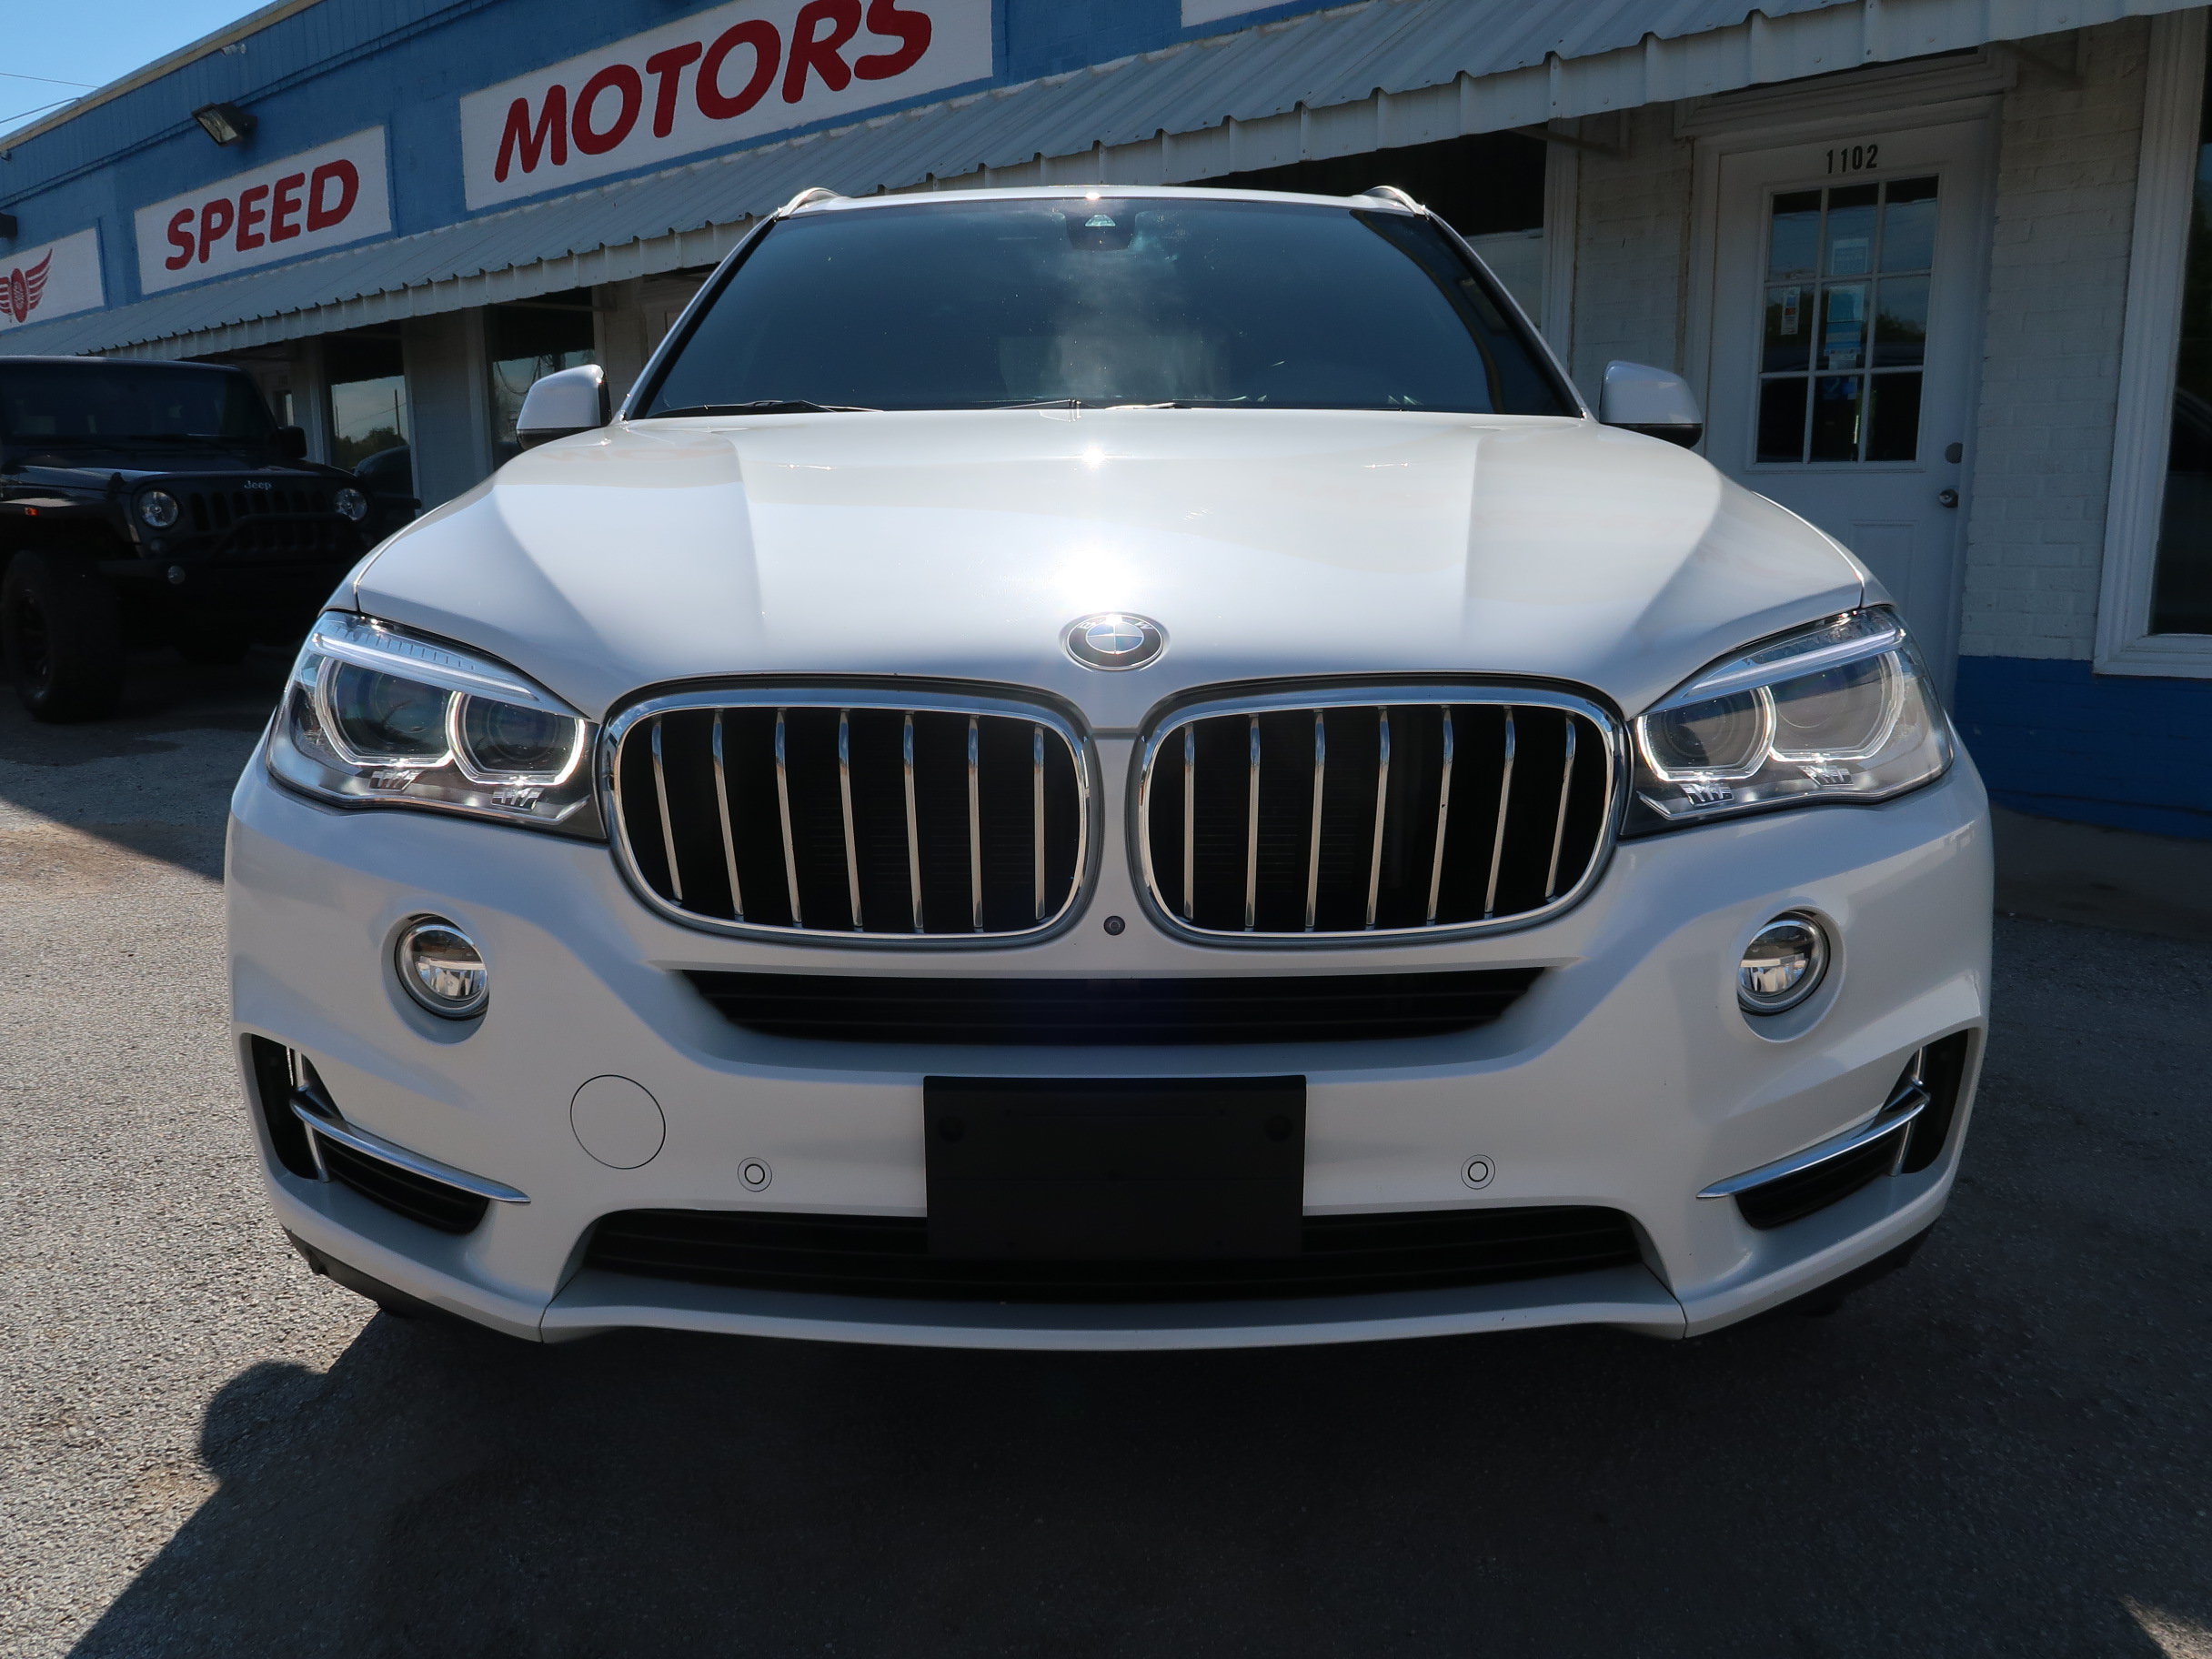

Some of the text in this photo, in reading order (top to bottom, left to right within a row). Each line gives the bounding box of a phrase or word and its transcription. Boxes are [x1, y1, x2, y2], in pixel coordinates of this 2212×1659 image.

[494, 0, 931, 183] MOTORS
[1826, 144, 1878, 174] 1102
[165, 158, 359, 270] SPEED
[244, 480, 272, 491] Jeep
